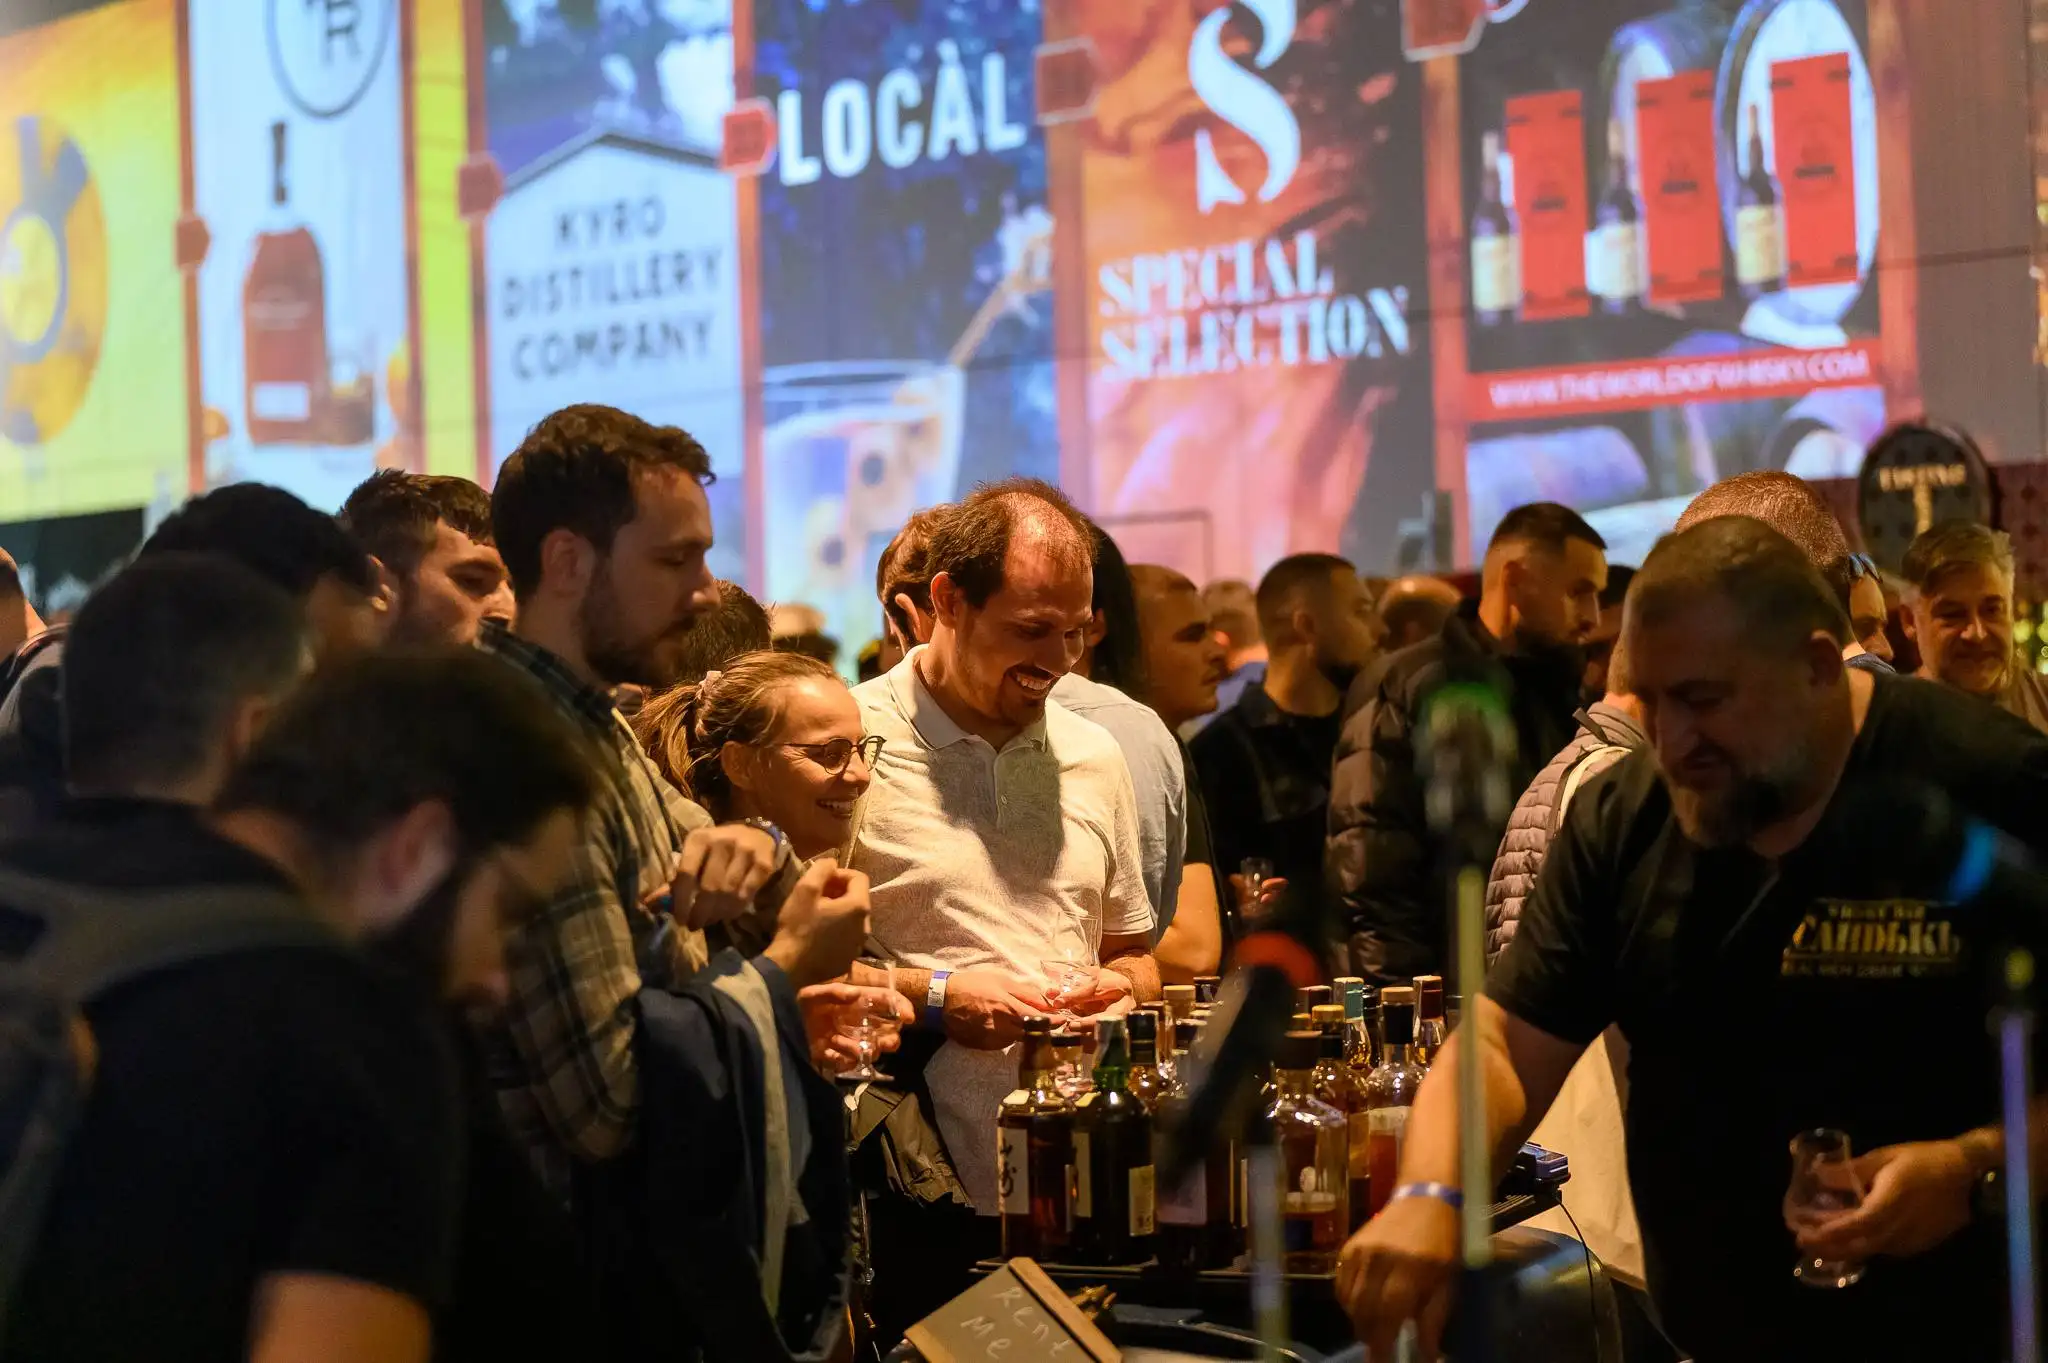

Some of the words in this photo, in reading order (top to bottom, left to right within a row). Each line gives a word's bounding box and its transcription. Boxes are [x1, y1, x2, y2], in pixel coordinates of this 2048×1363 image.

[1188, 0, 1300, 214] S
[502, 246, 722, 320] DISTILLERY
[1098, 229, 1335, 315] SPECIAL
[511, 313, 714, 379] COMPANY
[1100, 285, 1410, 382] SELECTION
[992, 1286, 1072, 1358] Rent
